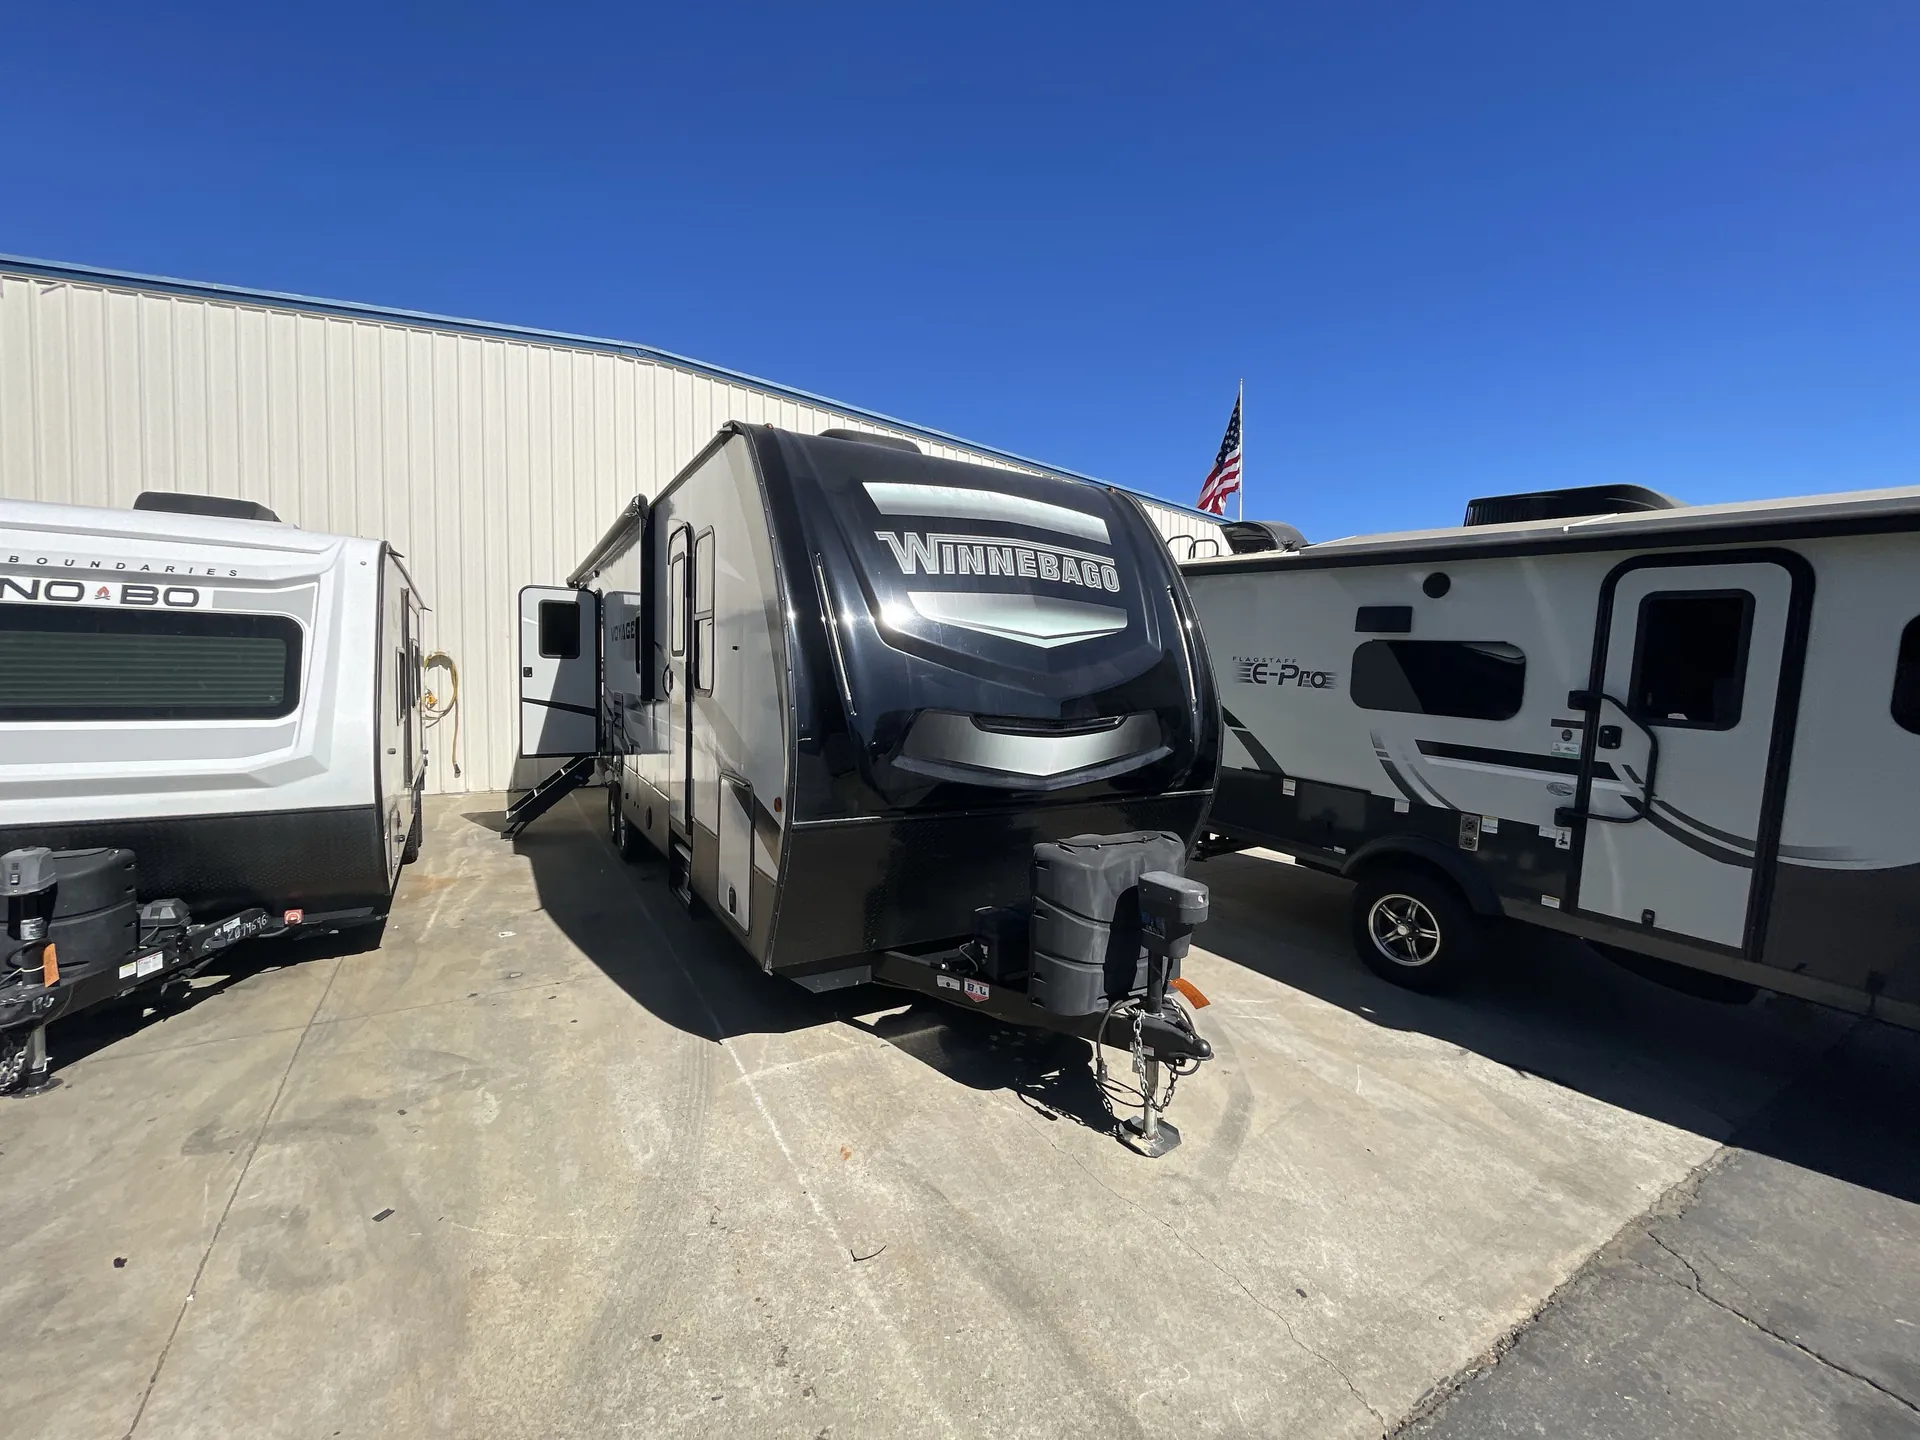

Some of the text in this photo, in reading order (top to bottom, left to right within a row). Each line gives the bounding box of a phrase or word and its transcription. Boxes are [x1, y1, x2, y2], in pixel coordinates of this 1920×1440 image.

[8, 555, 238, 577] BOUNDARIES
[874, 531, 1120, 593] WINNEBAGO
[0, 577, 200, 608] NO BO
[611, 620, 635, 641] VOYAGE
[1252, 663, 1327, 689] E-Pro
